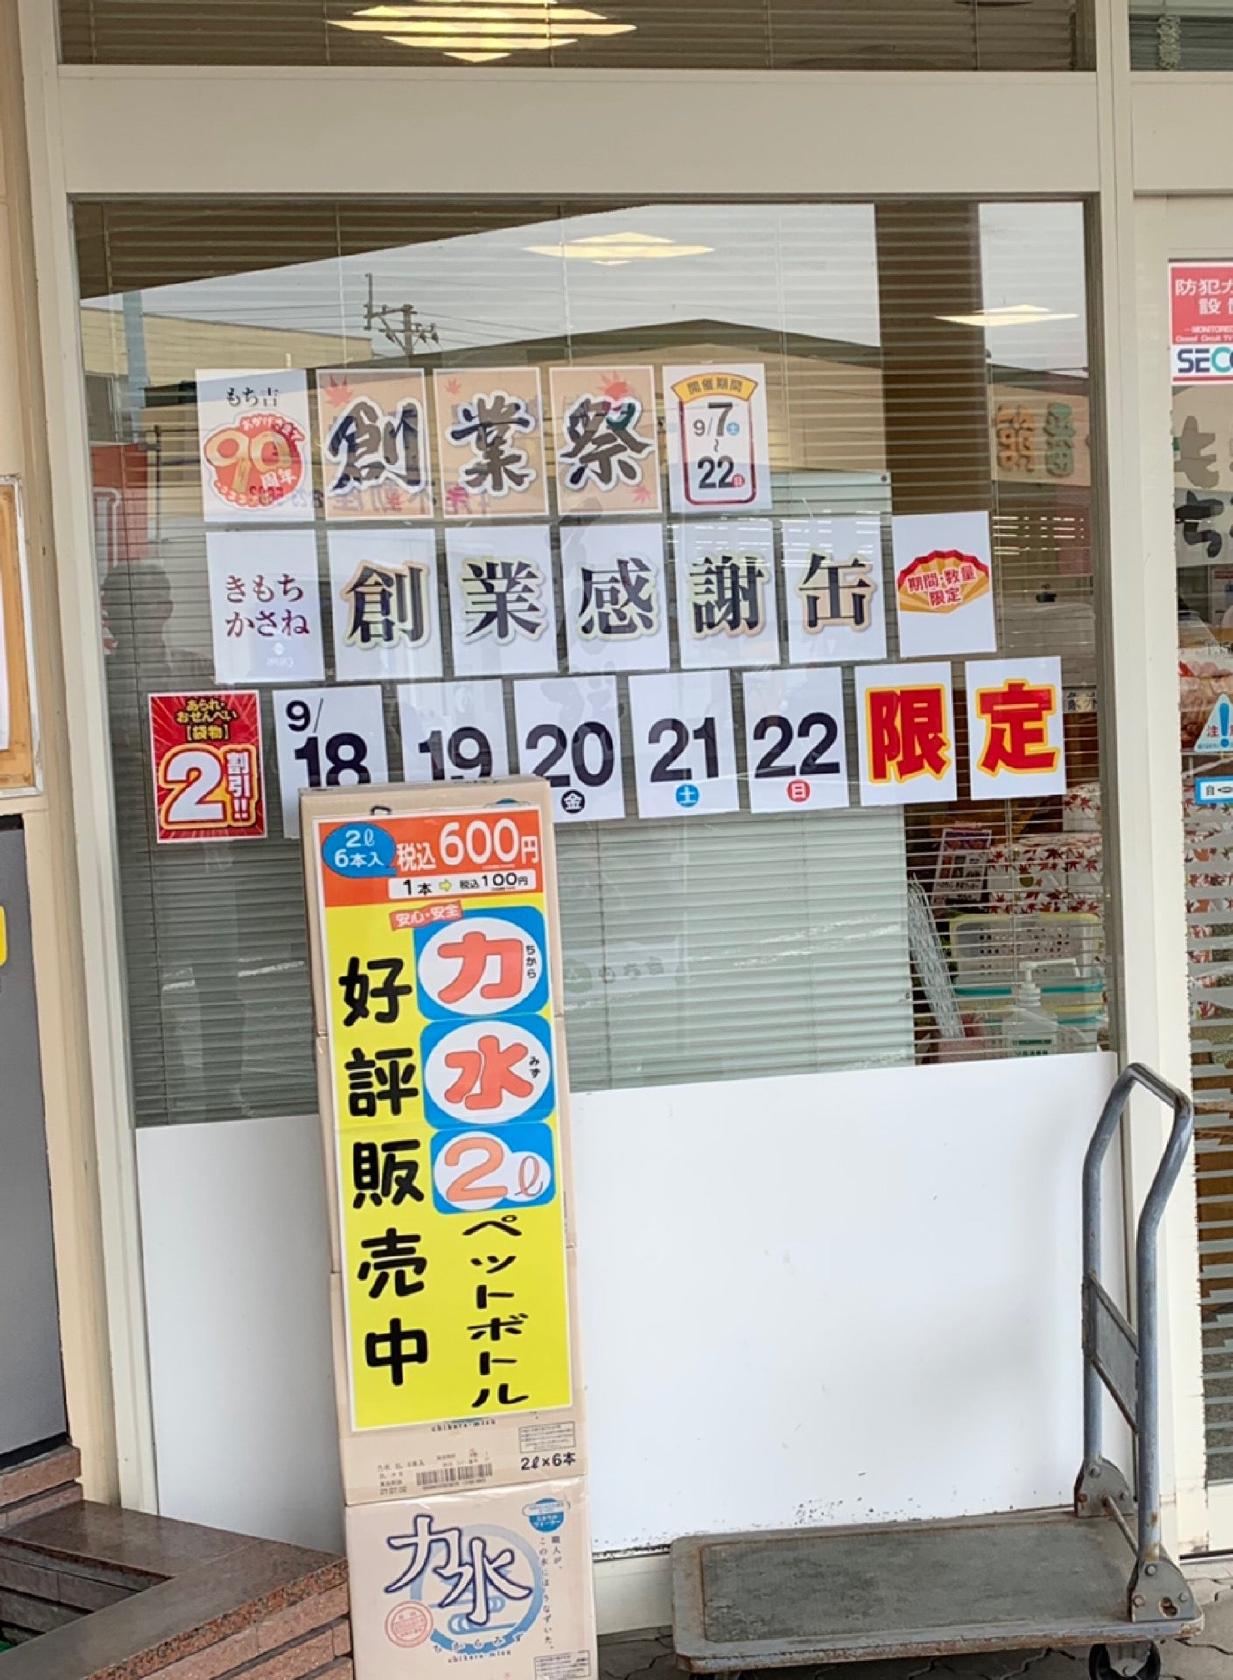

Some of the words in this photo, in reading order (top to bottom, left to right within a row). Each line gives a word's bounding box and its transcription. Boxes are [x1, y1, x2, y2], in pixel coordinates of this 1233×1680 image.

[1199, 298, 1233, 315] 設
[1177, 346, 1233, 373] SEC
[687, 377, 743, 394] 開催期間
[331, 394, 651, 491] 創業祭
[226, 573, 304, 603] きもち
[346, 553, 873, 646] 創業感謝缶
[929, 588, 961, 607] 限定
[225, 609, 310, 638] かさね
[176, 709, 238, 724] おせんべい
[525, 720, 614, 788] 20
[649, 718, 720, 783] 21
[753, 713, 842, 780] 22
[869, 682, 1056, 778] 限定
[334, 850, 384, 867] 6本入
[403, 879, 432, 896] 1本
[526, 945, 537, 979] ちから
[338, 956, 428, 1386] 好評販売中
[463, 1214, 529, 1407] ペットボトル
